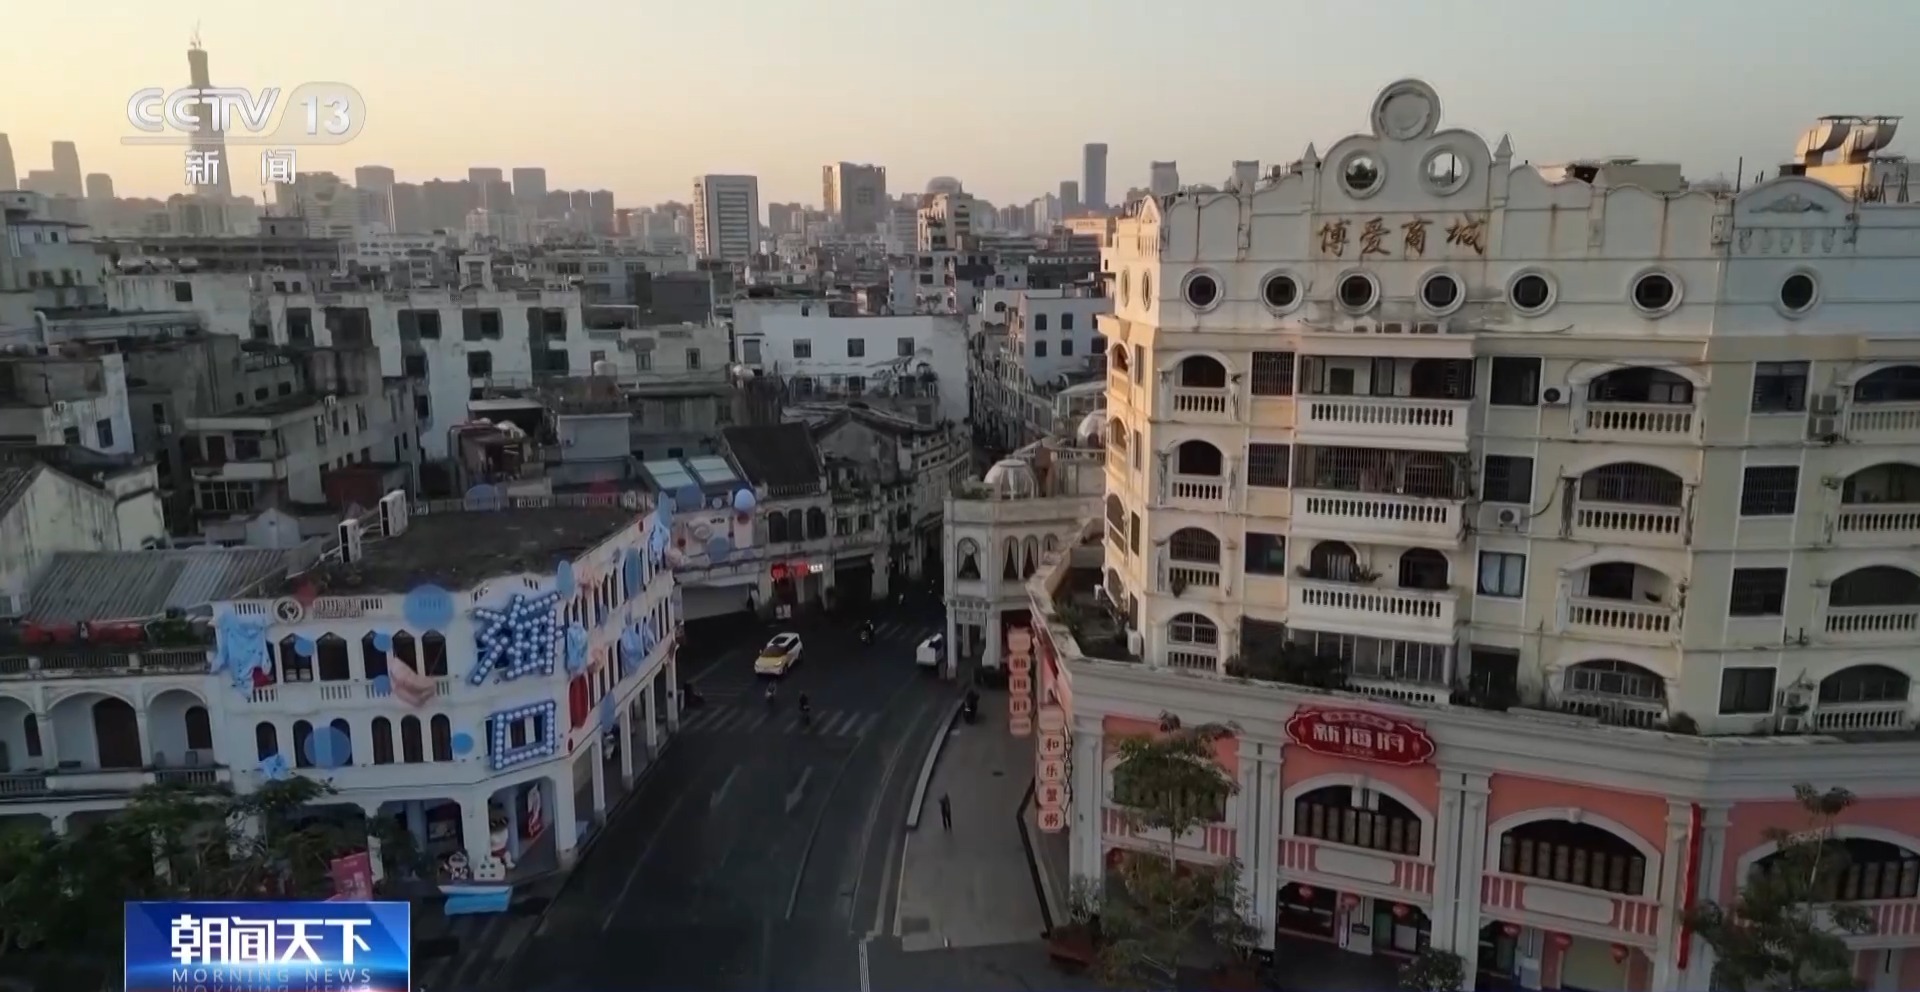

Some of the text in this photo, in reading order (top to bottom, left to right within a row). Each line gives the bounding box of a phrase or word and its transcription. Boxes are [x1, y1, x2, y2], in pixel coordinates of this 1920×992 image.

[1318, 216, 1486, 257] 博爱商城
[1313, 721, 1405, 753] 新海府
[1043, 736, 1060, 828] 和乐蟹粥
